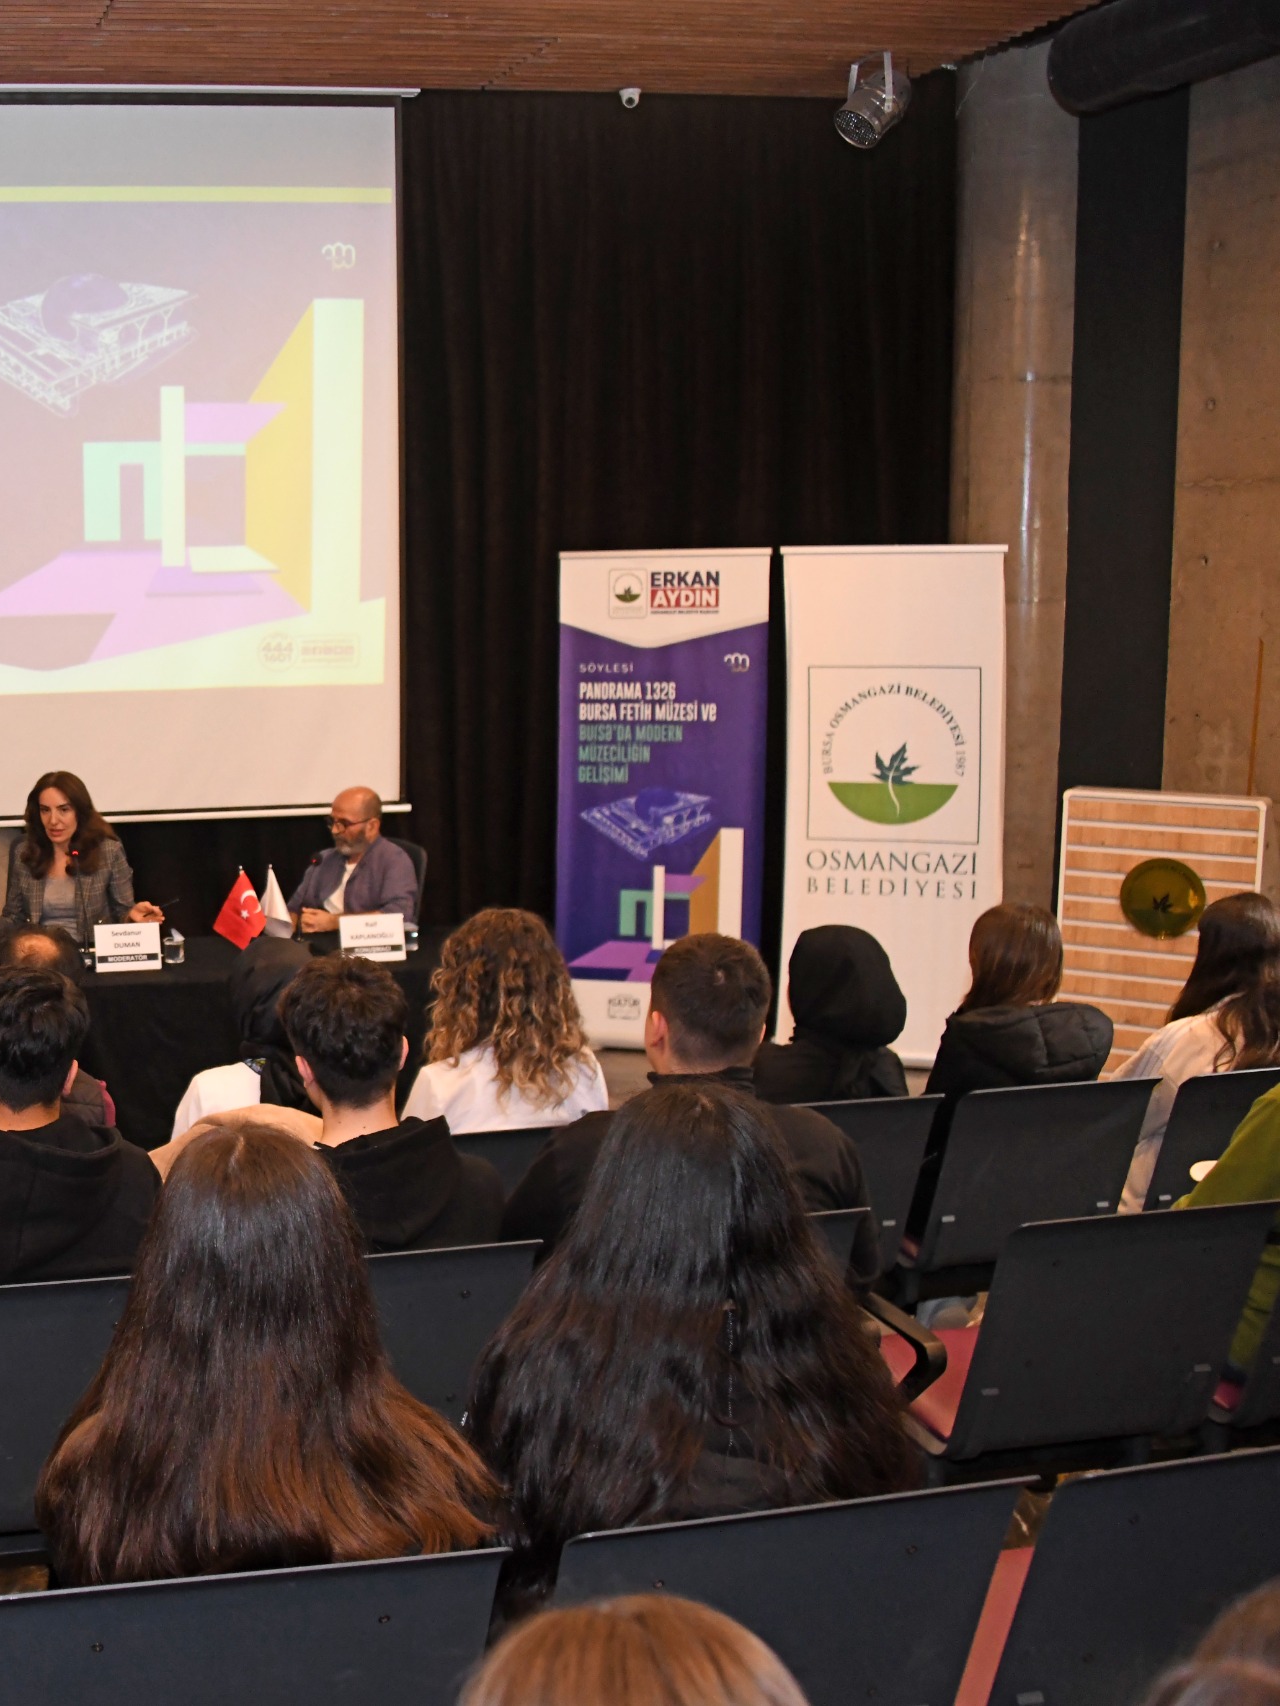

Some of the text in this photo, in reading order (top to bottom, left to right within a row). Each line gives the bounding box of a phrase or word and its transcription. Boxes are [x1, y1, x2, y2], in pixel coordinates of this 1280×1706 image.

[650, 571, 720, 587] ERKAN
[652, 589, 716, 607] AYDIN
[579, 682, 676, 700] PANORAMA 1326
[579, 703, 617, 721] BURSA
[619, 701, 652, 721] FETİH
[655, 700, 698, 721] MÜZESİ
[635, 725, 683, 742] MODERN
[822, 732, 835, 775] BURSA
[829, 683, 902, 729] OSMANGAZİ
[905, 686, 967, 747] BELEDİYESİ
